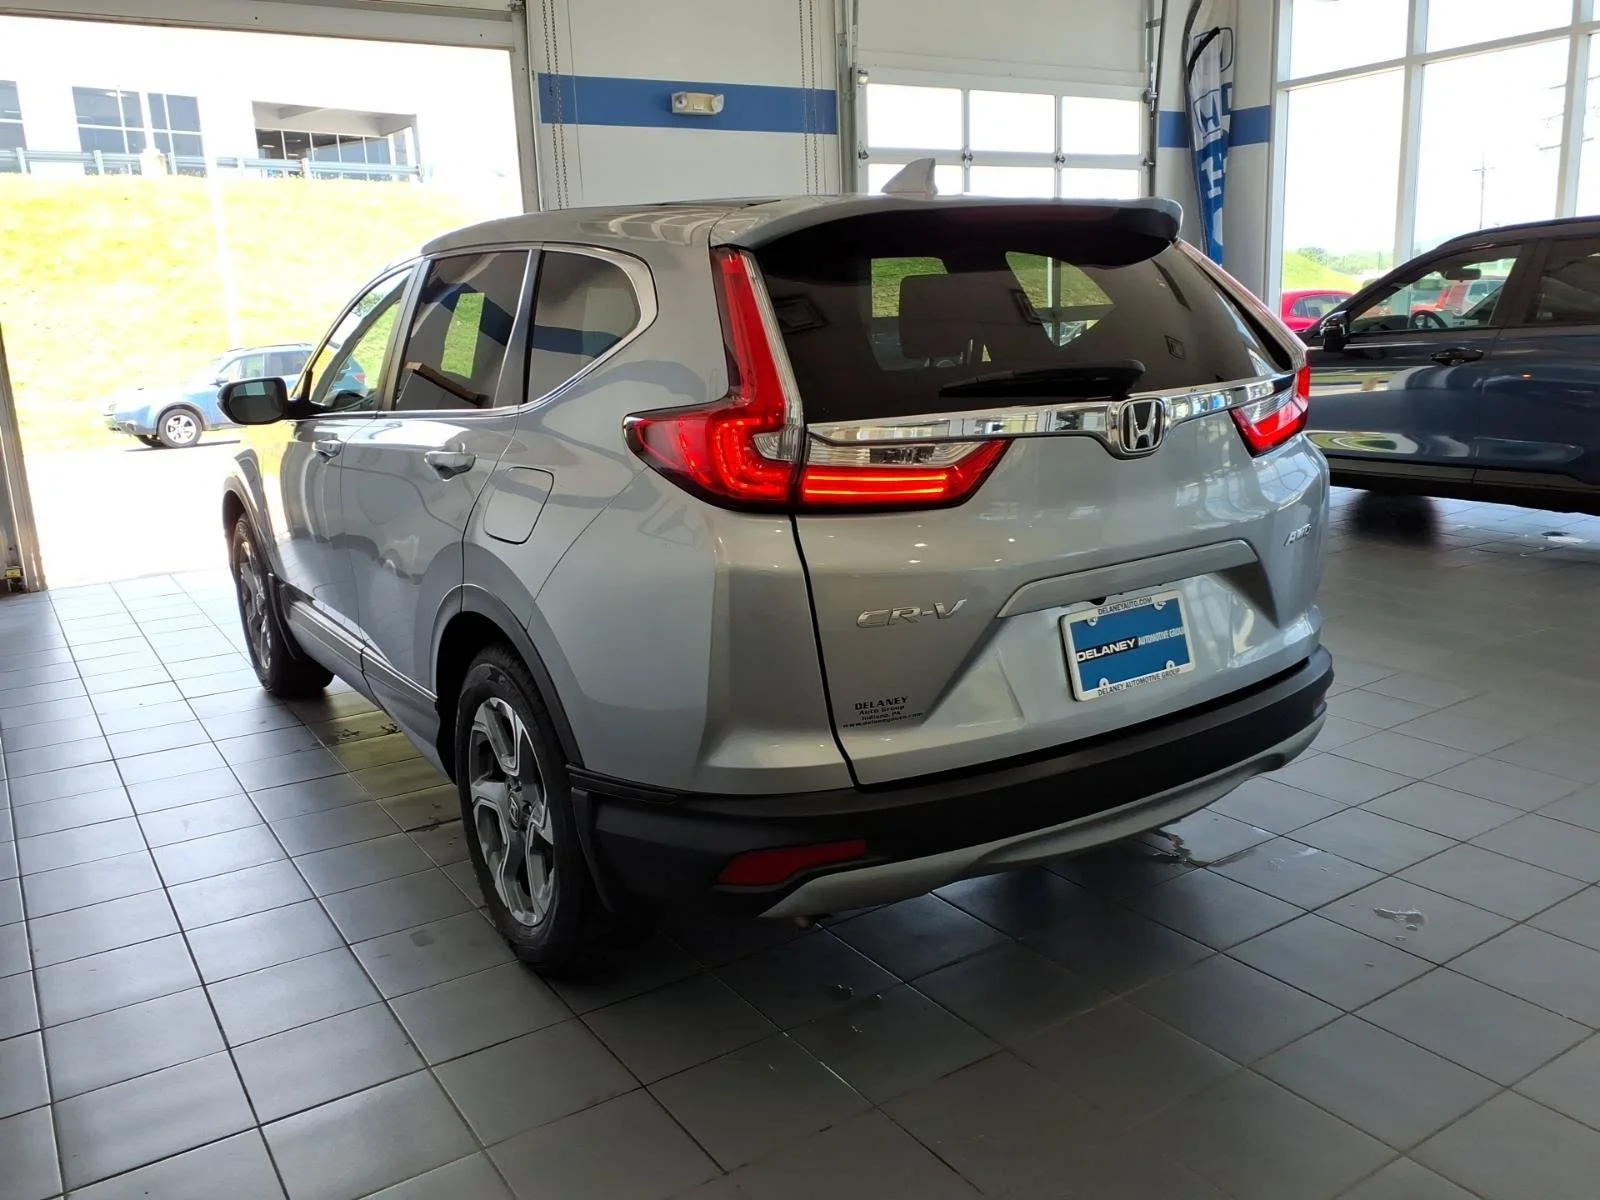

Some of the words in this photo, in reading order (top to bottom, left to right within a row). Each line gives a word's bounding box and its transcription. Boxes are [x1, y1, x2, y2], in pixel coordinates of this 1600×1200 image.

[1284, 523, 1312, 546] AWD
[856, 598, 968, 629] CR-V
[1097, 596, 1153, 615] DELANEYAUTO.COM
[1076, 638, 1136, 662] DELANEY
[1138, 629, 1170, 646] AUTOMOTIVE
[1169, 625, 1186, 638] GROU
[1097, 683, 1125, 697] DELANEY
[1125, 674, 1161, 689] AUTOMOTIVE
[1161, 667, 1181, 680] GROUP
[854, 696, 909, 711] DELANEY
[859, 708, 879, 716] Auto
[881, 704, 905, 713] Group
